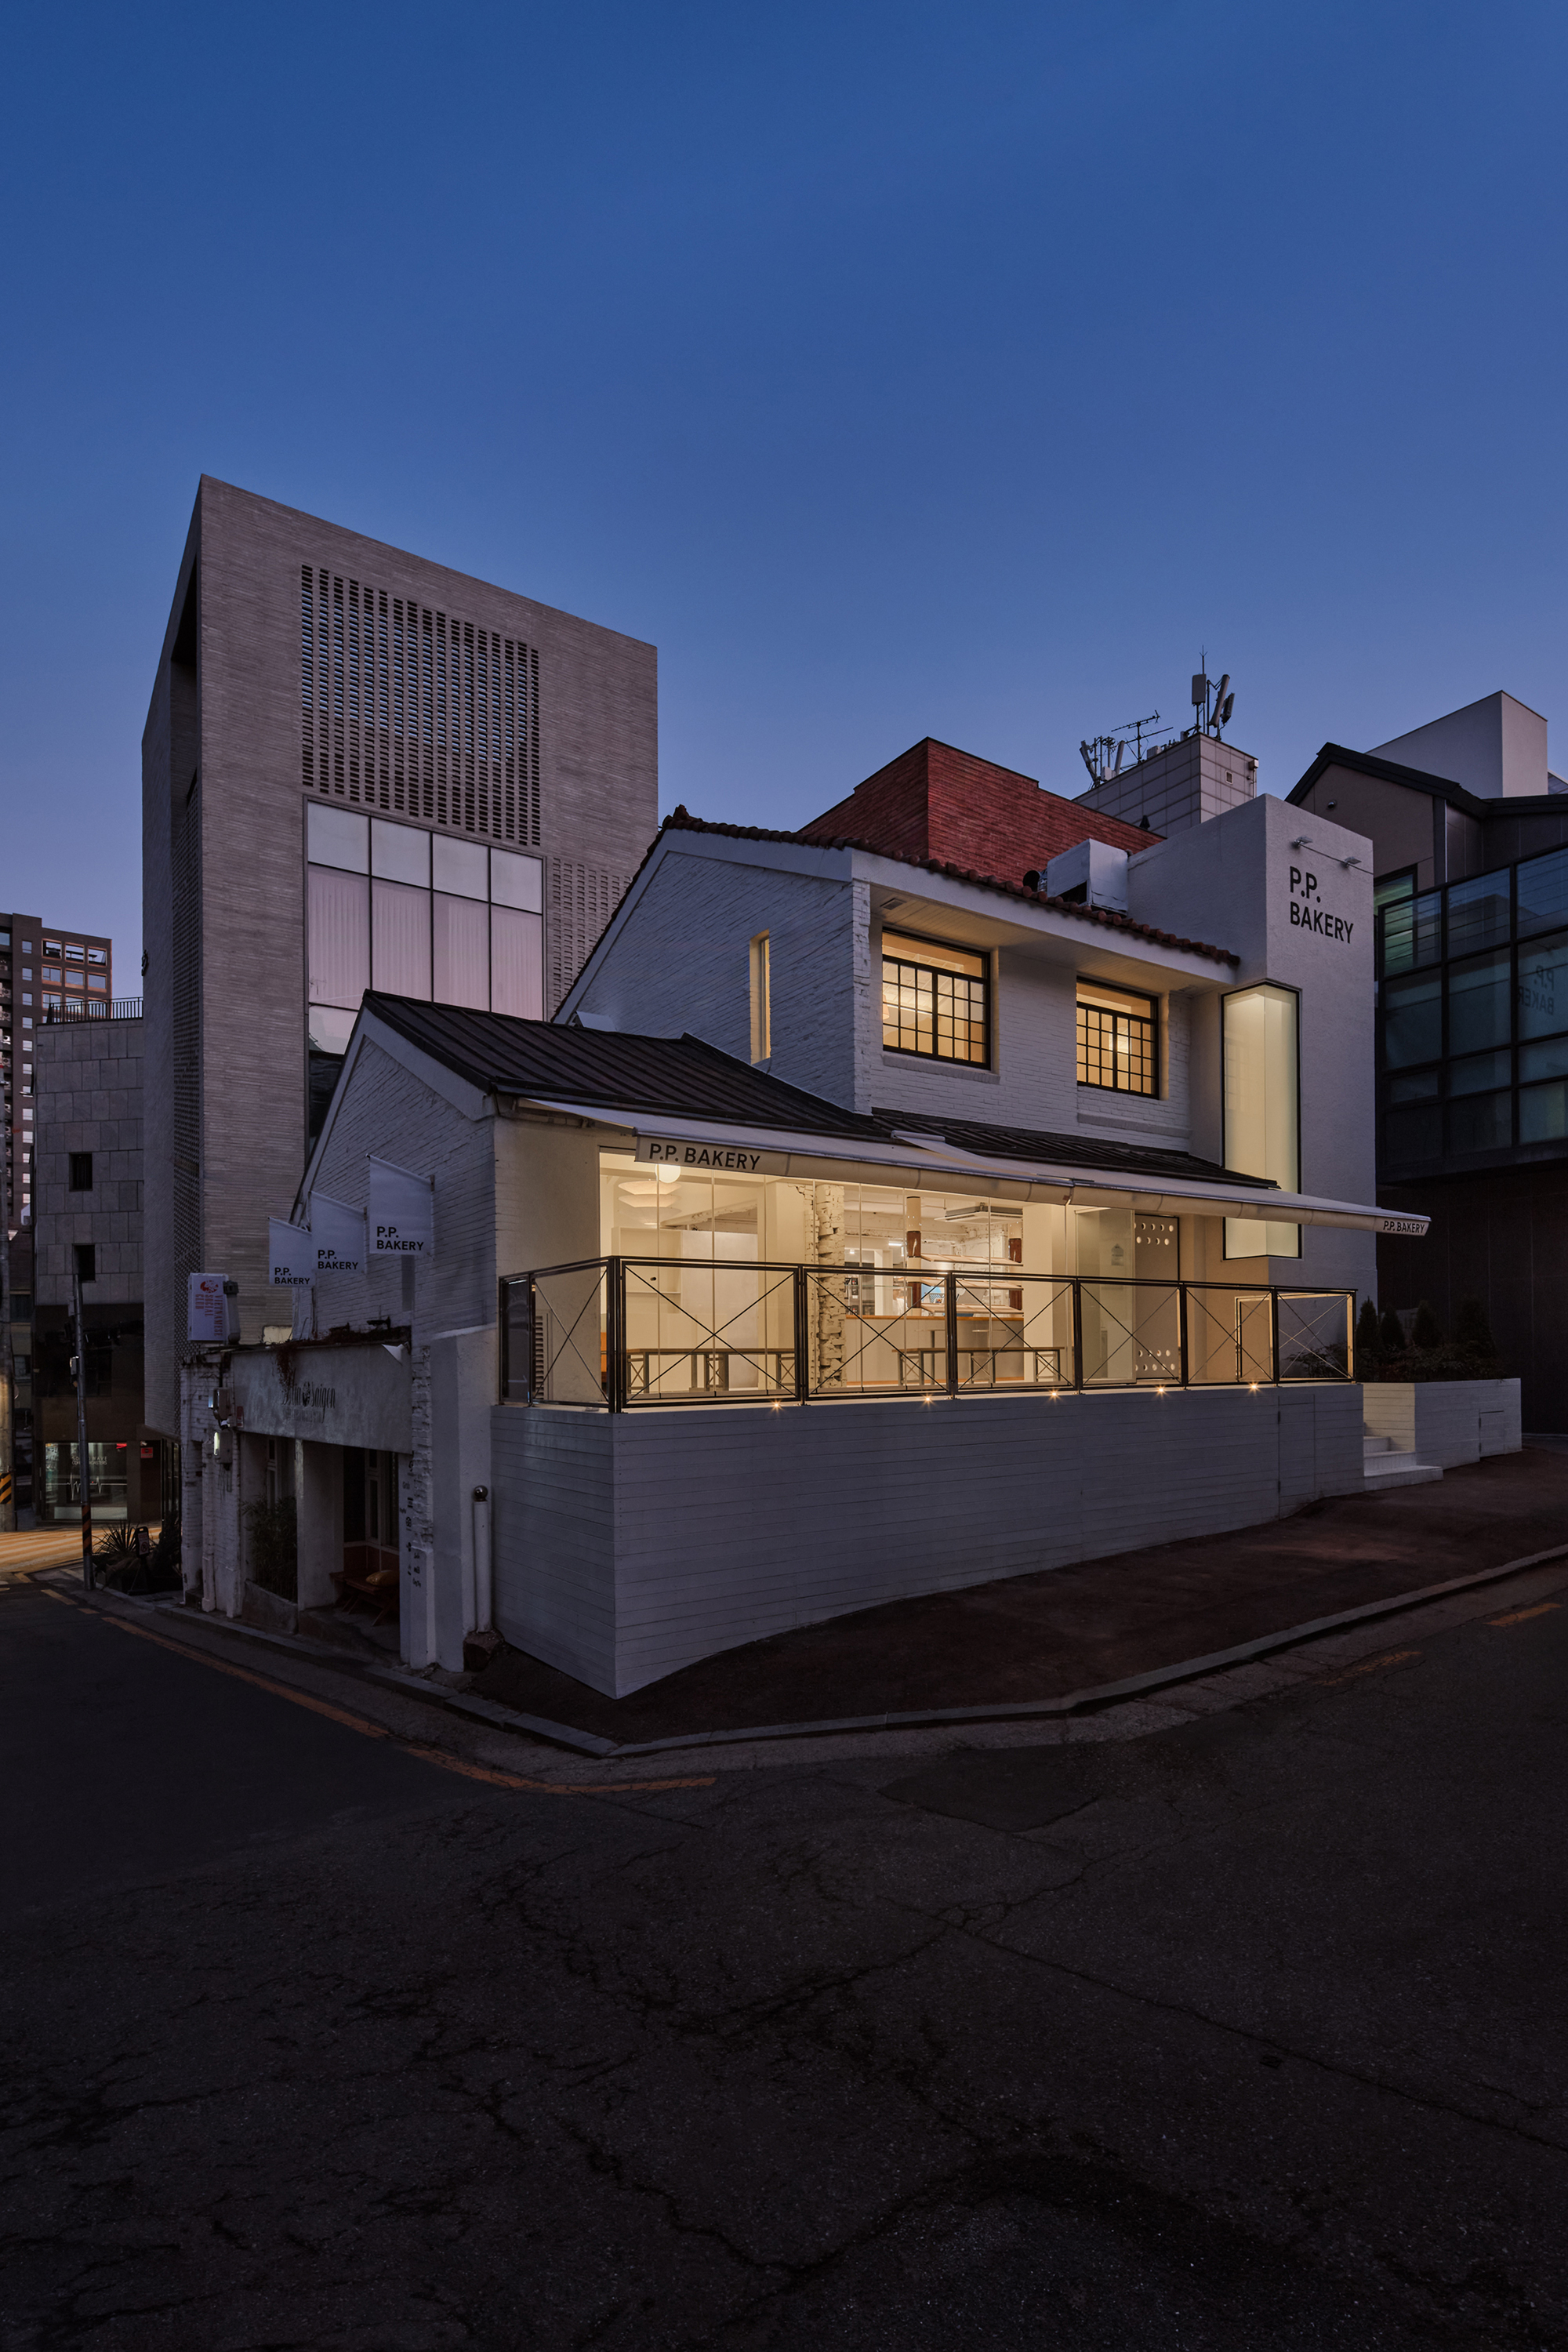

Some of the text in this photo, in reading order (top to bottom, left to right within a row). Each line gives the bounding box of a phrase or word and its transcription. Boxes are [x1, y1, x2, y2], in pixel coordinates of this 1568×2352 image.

[1290, 866, 1321, 903] P.P.
[1290, 901, 1354, 944] BAKERY
[649, 1143, 760, 1170] P.P. BAKERY
[377, 1226, 399, 1238] P.P.
[1383, 1220, 1425, 1233] P.P. BAKERY
[377, 1240, 424, 1250] BAKERY
[318, 1250, 337, 1259] P.P.
[274, 1267, 292, 1276] P.P.
[318, 1261, 358, 1270] BAKERY
[195, 1294, 204, 1309] CLUB
[205, 1294, 213, 1317] SOCIAL
[214, 1294, 223, 1337] VIETNAMESE
